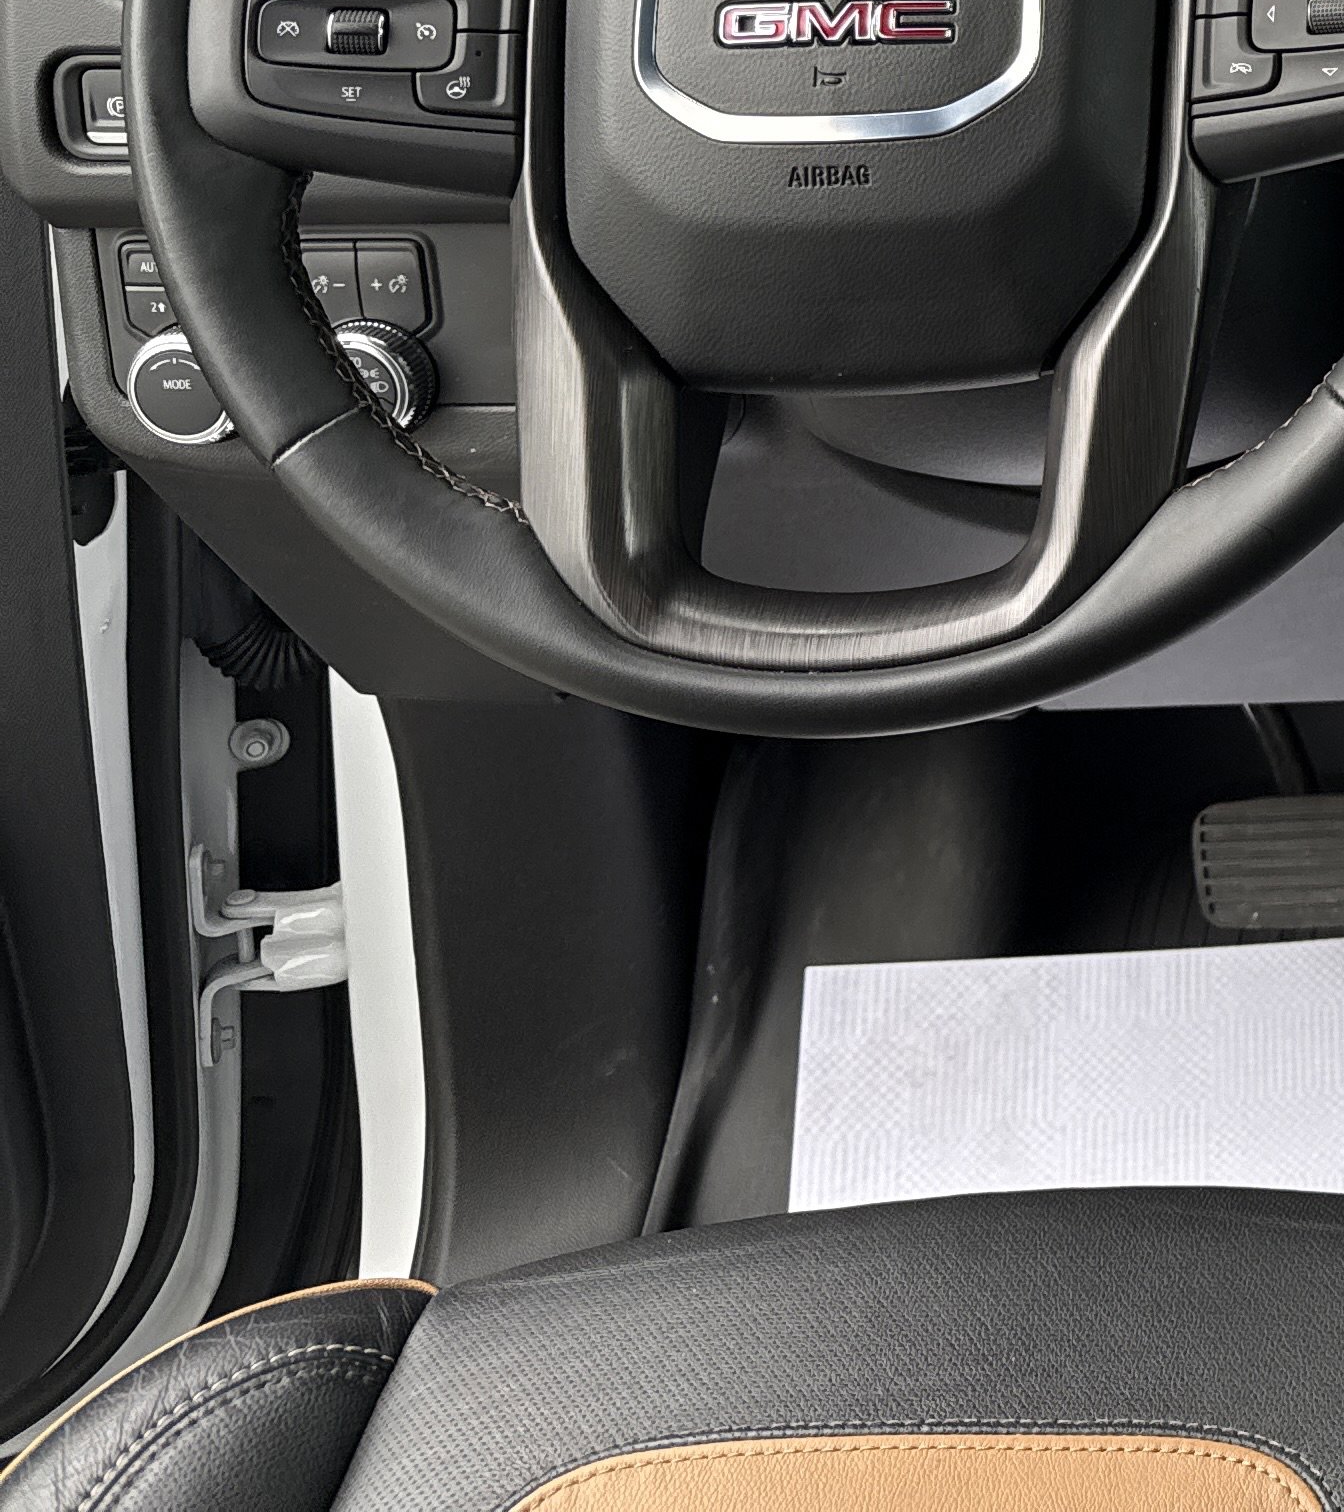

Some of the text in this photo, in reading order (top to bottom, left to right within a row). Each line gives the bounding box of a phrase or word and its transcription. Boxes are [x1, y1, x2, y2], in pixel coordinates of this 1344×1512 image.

[341, 86, 362, 98] SET
[787, 164, 871, 188] AIRBAG
[150, 302, 158, 313] 2
[163, 379, 192, 390] MODE
